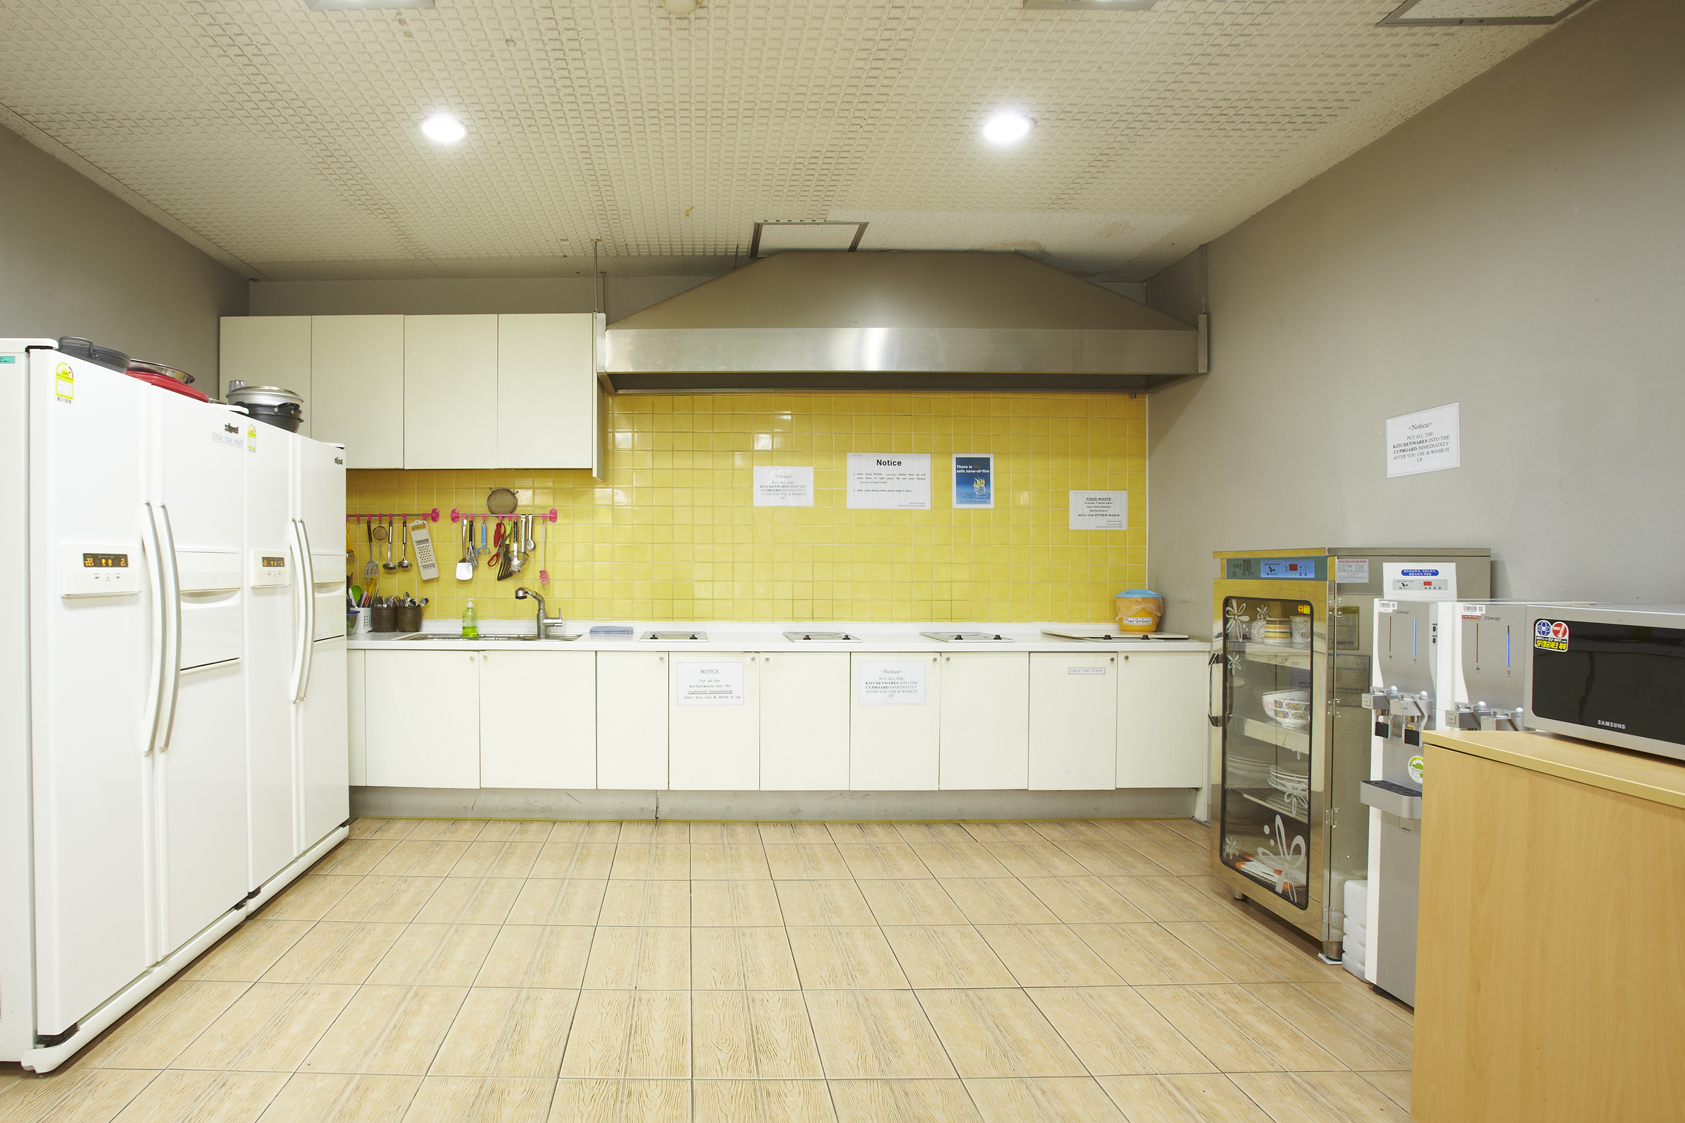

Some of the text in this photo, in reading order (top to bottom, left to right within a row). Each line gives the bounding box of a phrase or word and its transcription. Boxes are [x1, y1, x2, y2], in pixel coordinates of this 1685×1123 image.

[212, 431, 223, 441] Only
[1392, 439, 1428, 449] KITCHENWARES
[1393, 441, 1449, 454] CUPBOARD IMMEDIATELY
[1597, 720, 1626, 730] SAMSUNG
